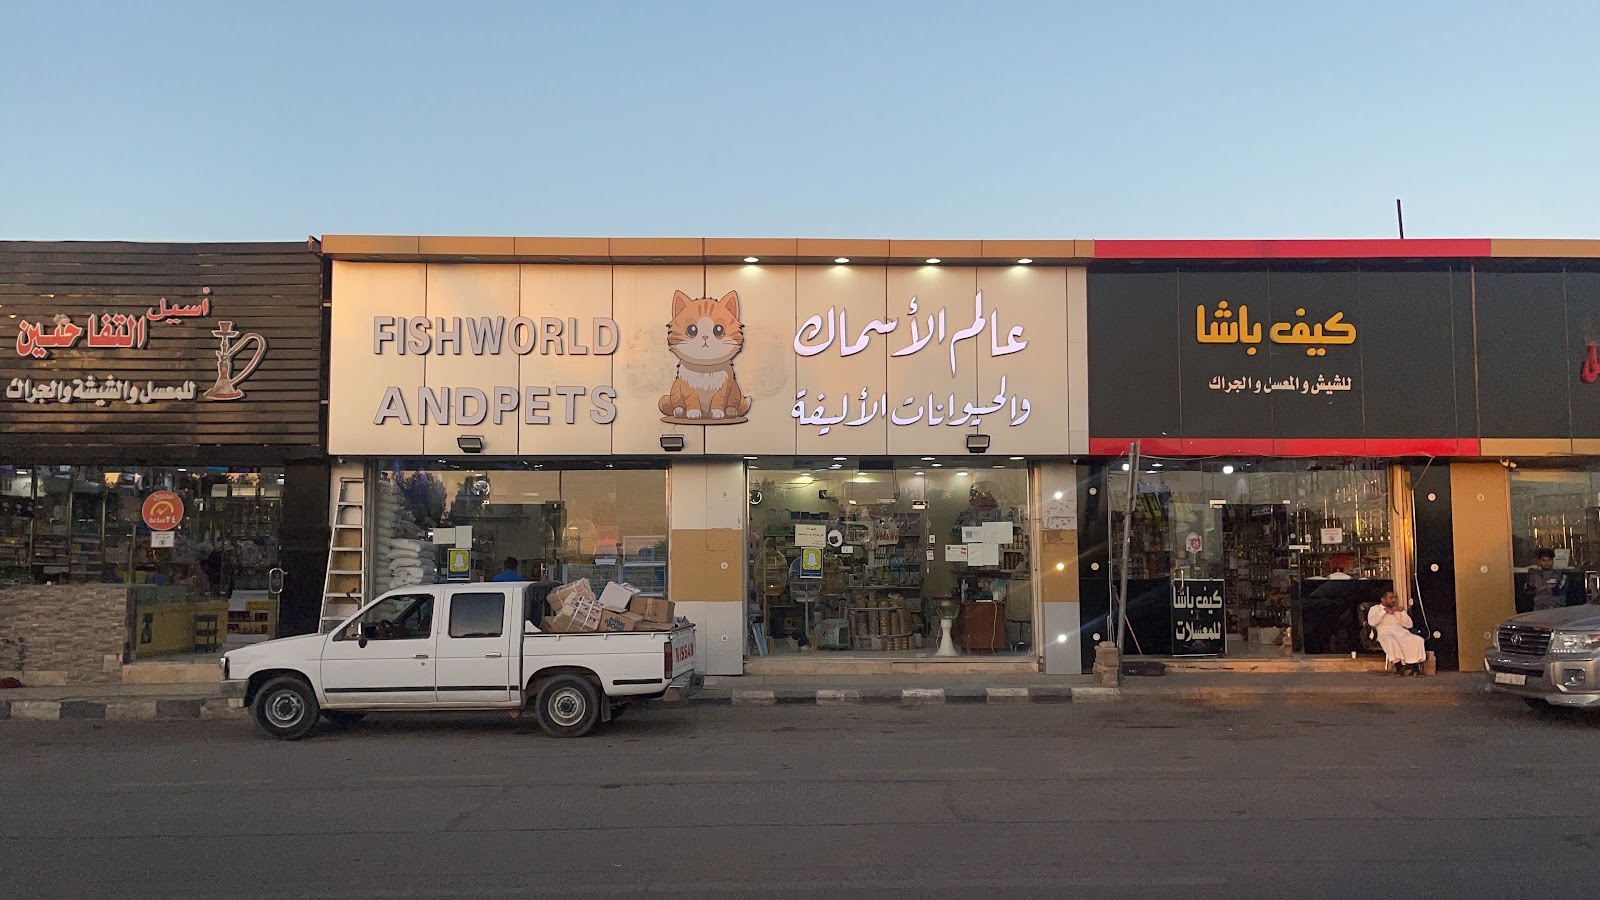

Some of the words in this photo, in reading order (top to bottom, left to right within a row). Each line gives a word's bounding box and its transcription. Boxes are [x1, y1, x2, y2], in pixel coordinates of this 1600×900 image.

[793, 295, 945, 357] الأسماك
[950, 289, 1028, 377] عالم
[1196, 300, 1262, 356] باشا
[1269, 307, 1357, 356] كيف
[140, 380, 196, 404] للمعسل
[891, 374, 1031, 427] والحيوانات
[1310, 374, 1352, 395] للشيش
[790, 386, 887, 436] الأليفة
[1173, 585, 1194, 615] باشا
[1195, 586, 1223, 615] كيف
[675, 642, 694, 663] NISSAN
